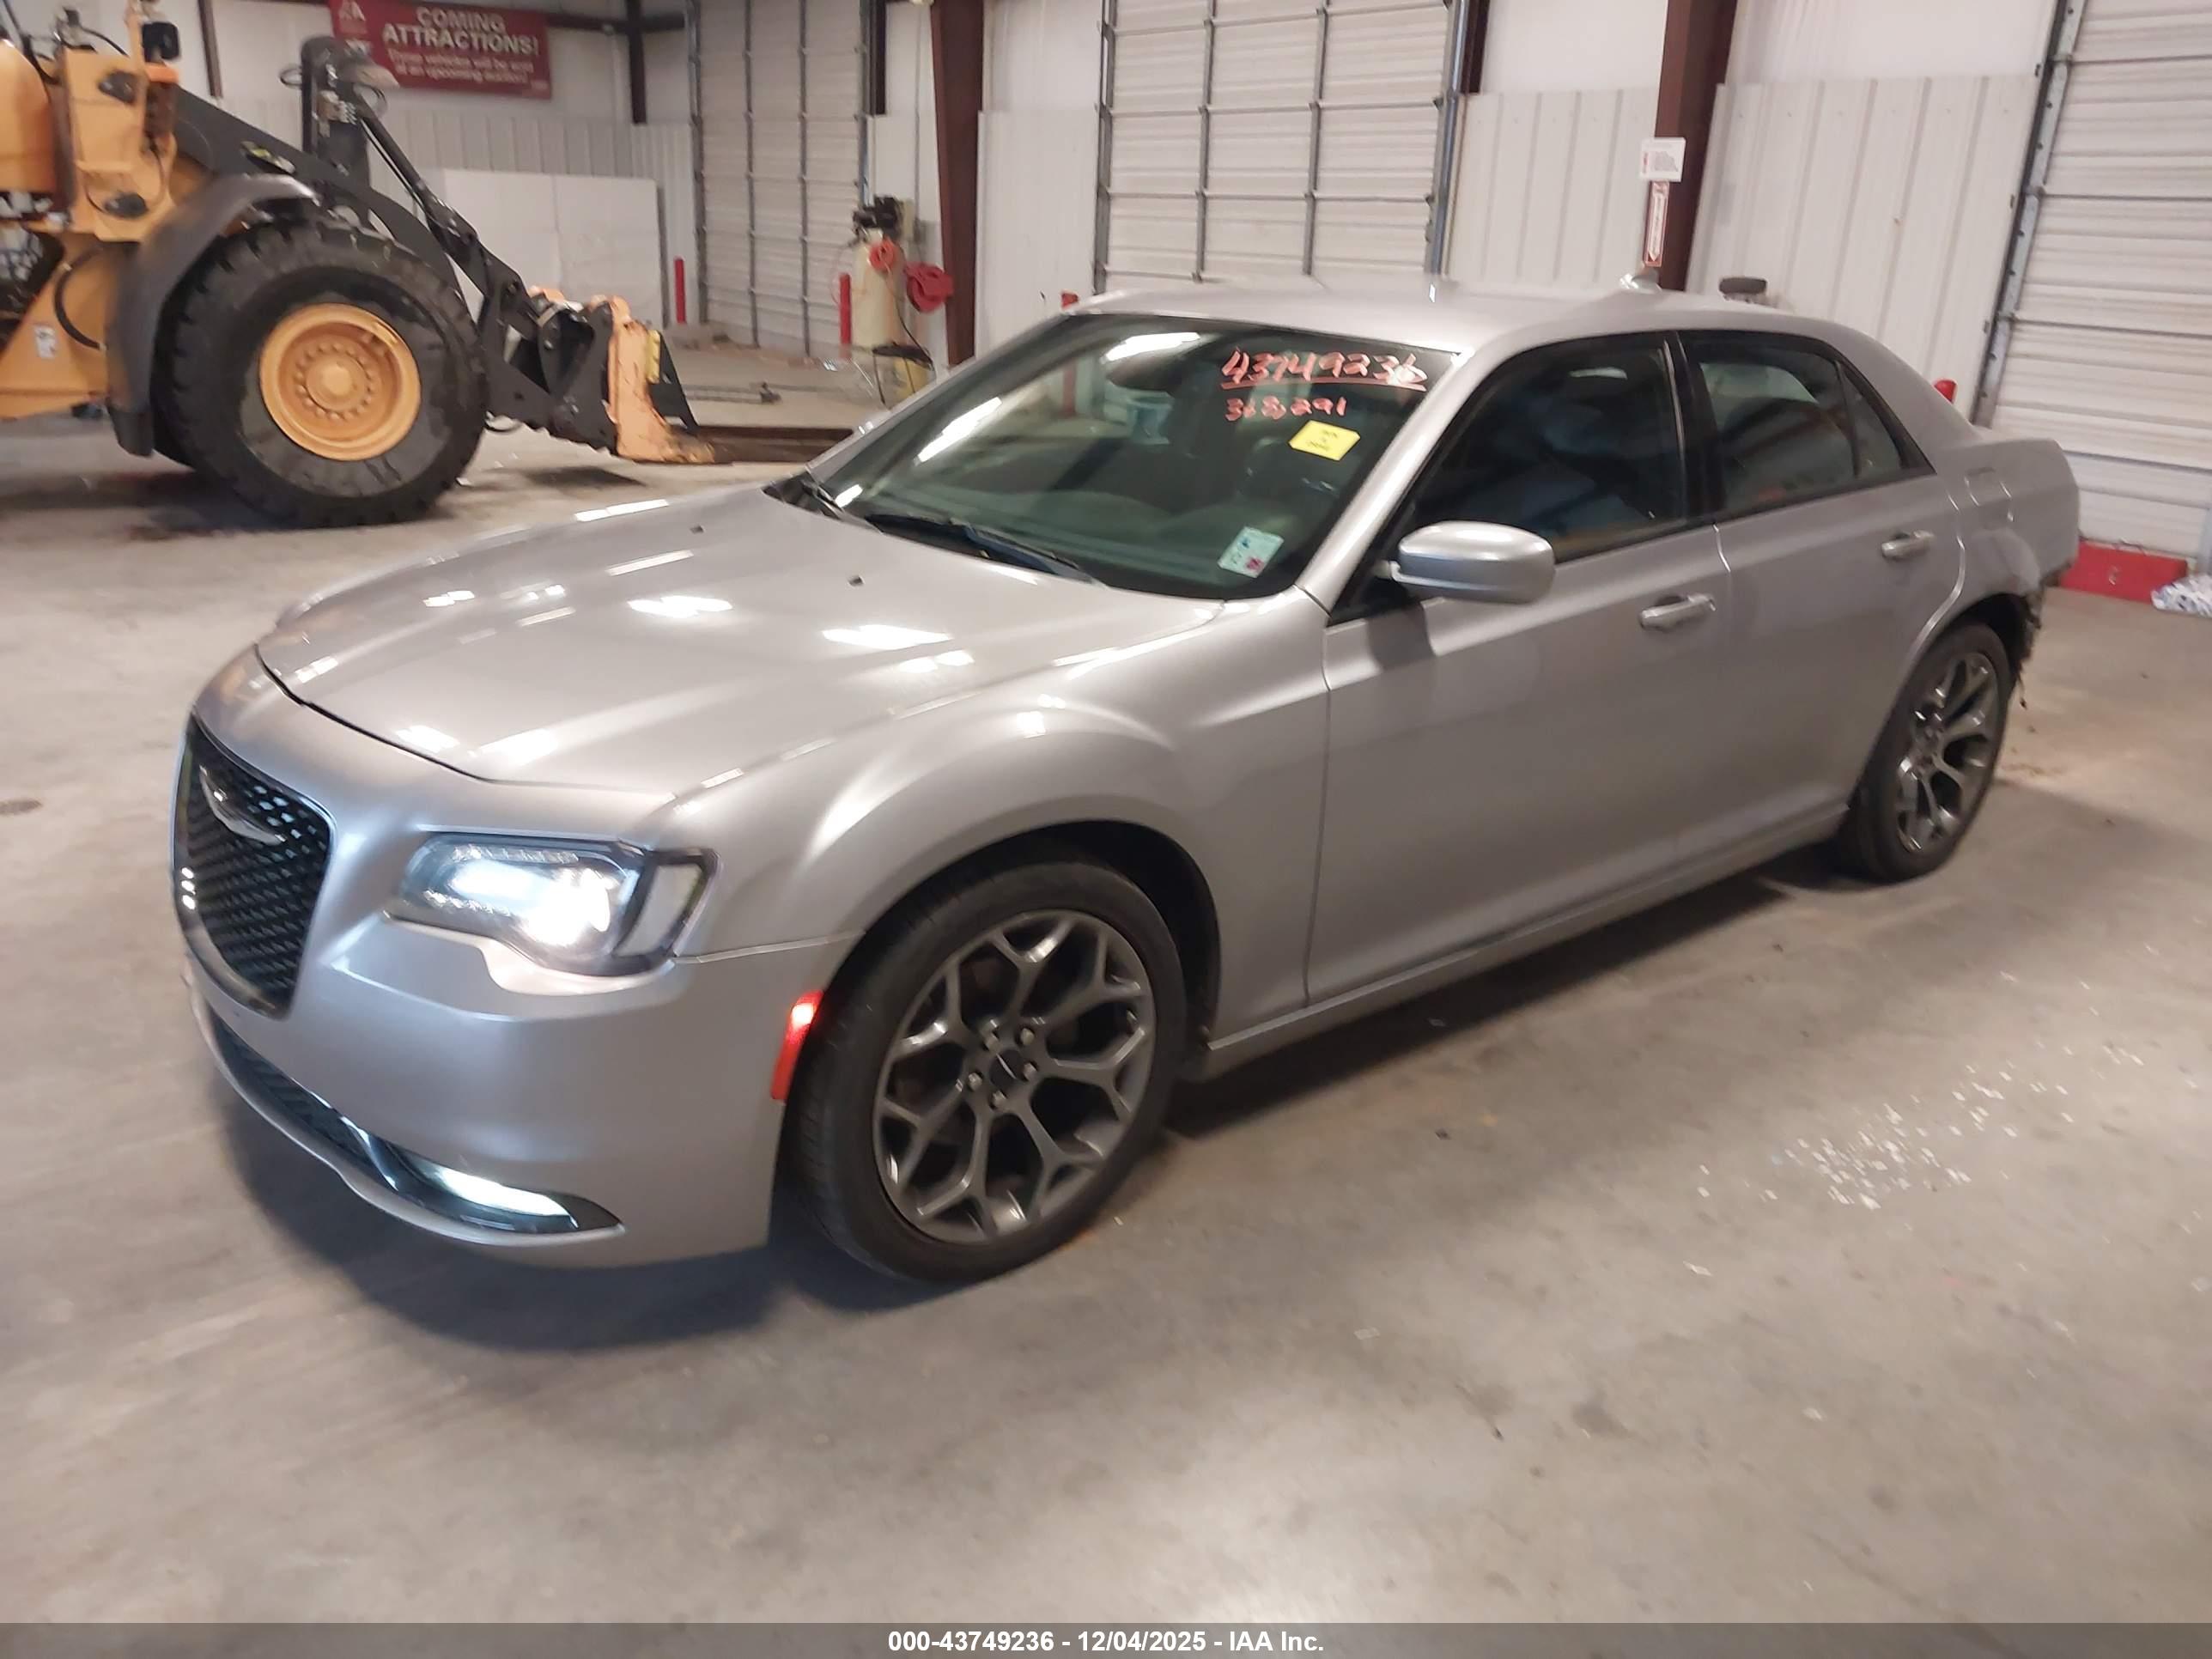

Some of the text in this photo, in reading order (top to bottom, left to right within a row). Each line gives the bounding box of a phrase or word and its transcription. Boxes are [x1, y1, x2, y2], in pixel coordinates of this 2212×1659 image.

[416, 7, 507, 33] COMING
[383, 23, 539, 56] ATTRACTIONS!
[1221, 346, 1427, 386] 43749236
